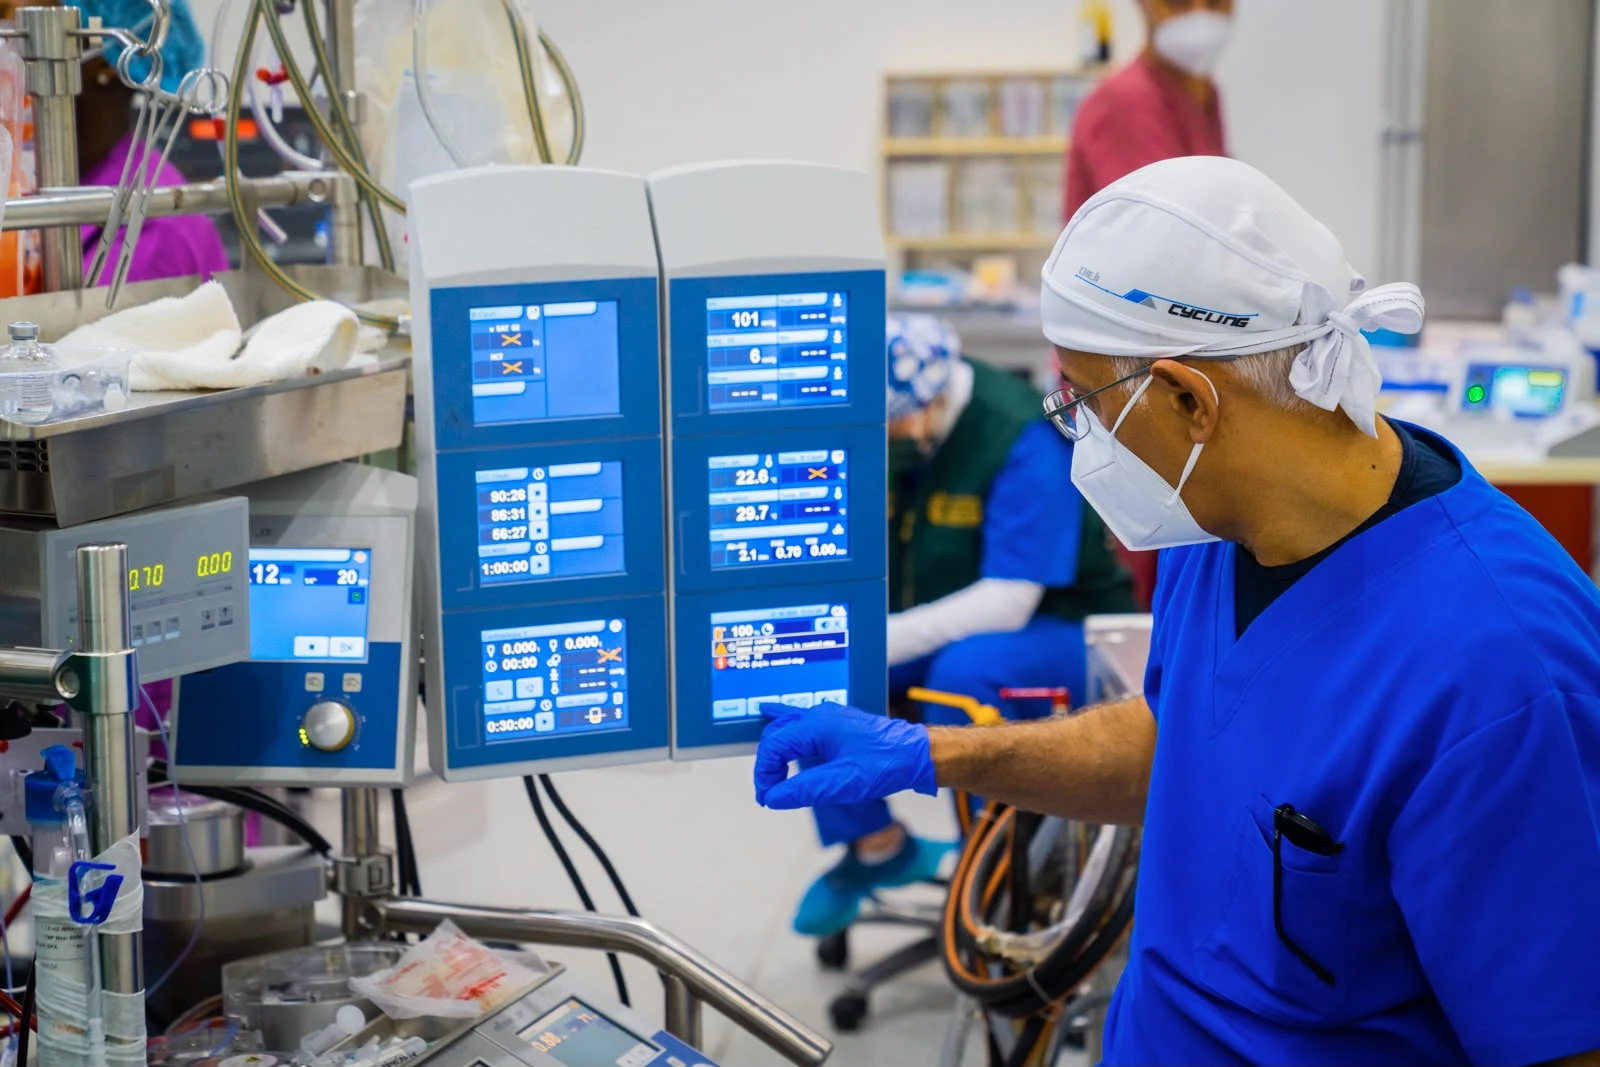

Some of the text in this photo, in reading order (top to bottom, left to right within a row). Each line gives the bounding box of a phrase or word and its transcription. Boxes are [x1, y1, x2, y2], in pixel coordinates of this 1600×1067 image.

[732, 311, 759, 328] 101
[1167, 303, 1250, 328] CYCLING
[750, 348, 761, 364] 6
[736, 469, 769, 486] 22.6
[736, 505, 770, 522] 29.7
[776, 545, 803, 559] 0.70
[198, 551, 233, 578] 0.00
[482, 560, 529, 576] 1:00:00
[129, 564, 165, 591] 0.70
[337, 570, 359, 586] 20
[731, 624, 754, 638] 100
[503, 636, 600, 656] 0.000 0.000
[502, 656, 539, 671] 00:00
[487, 717, 534, 734] 0:30:00
